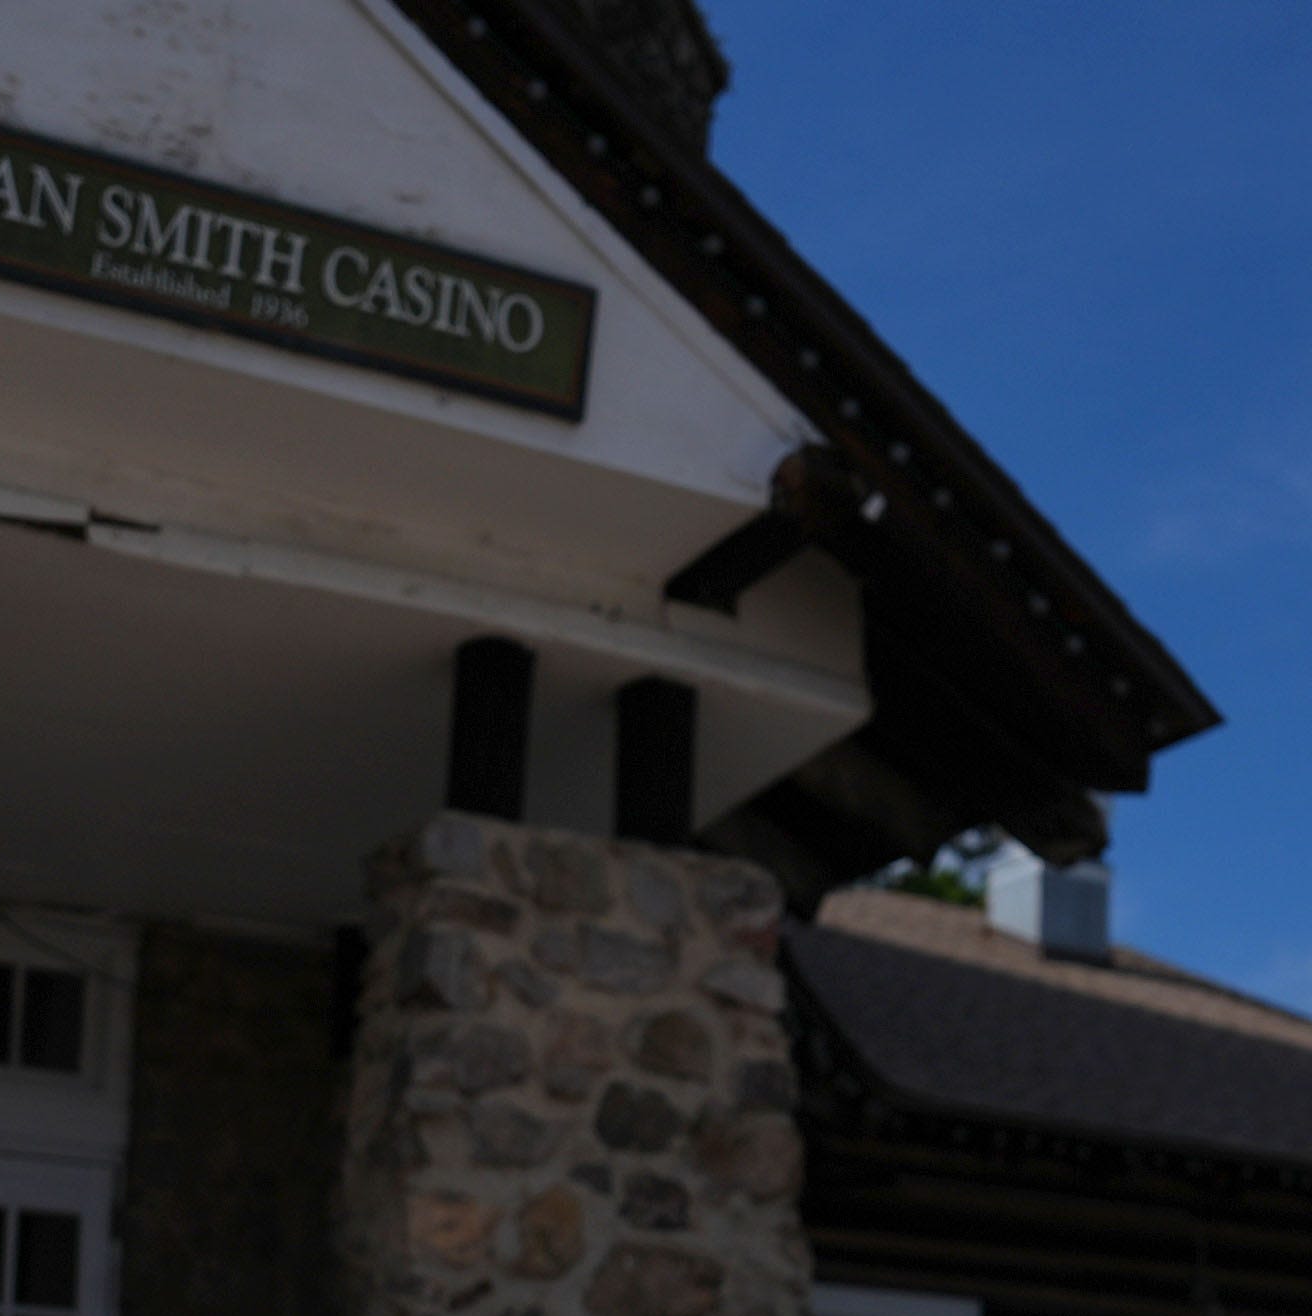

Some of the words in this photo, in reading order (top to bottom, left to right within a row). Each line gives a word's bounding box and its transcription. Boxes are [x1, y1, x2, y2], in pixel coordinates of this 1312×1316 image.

[90, 249, 233, 311] Established
[97, 184, 309, 294] SMITH
[322, 246, 545, 354] CASINO
